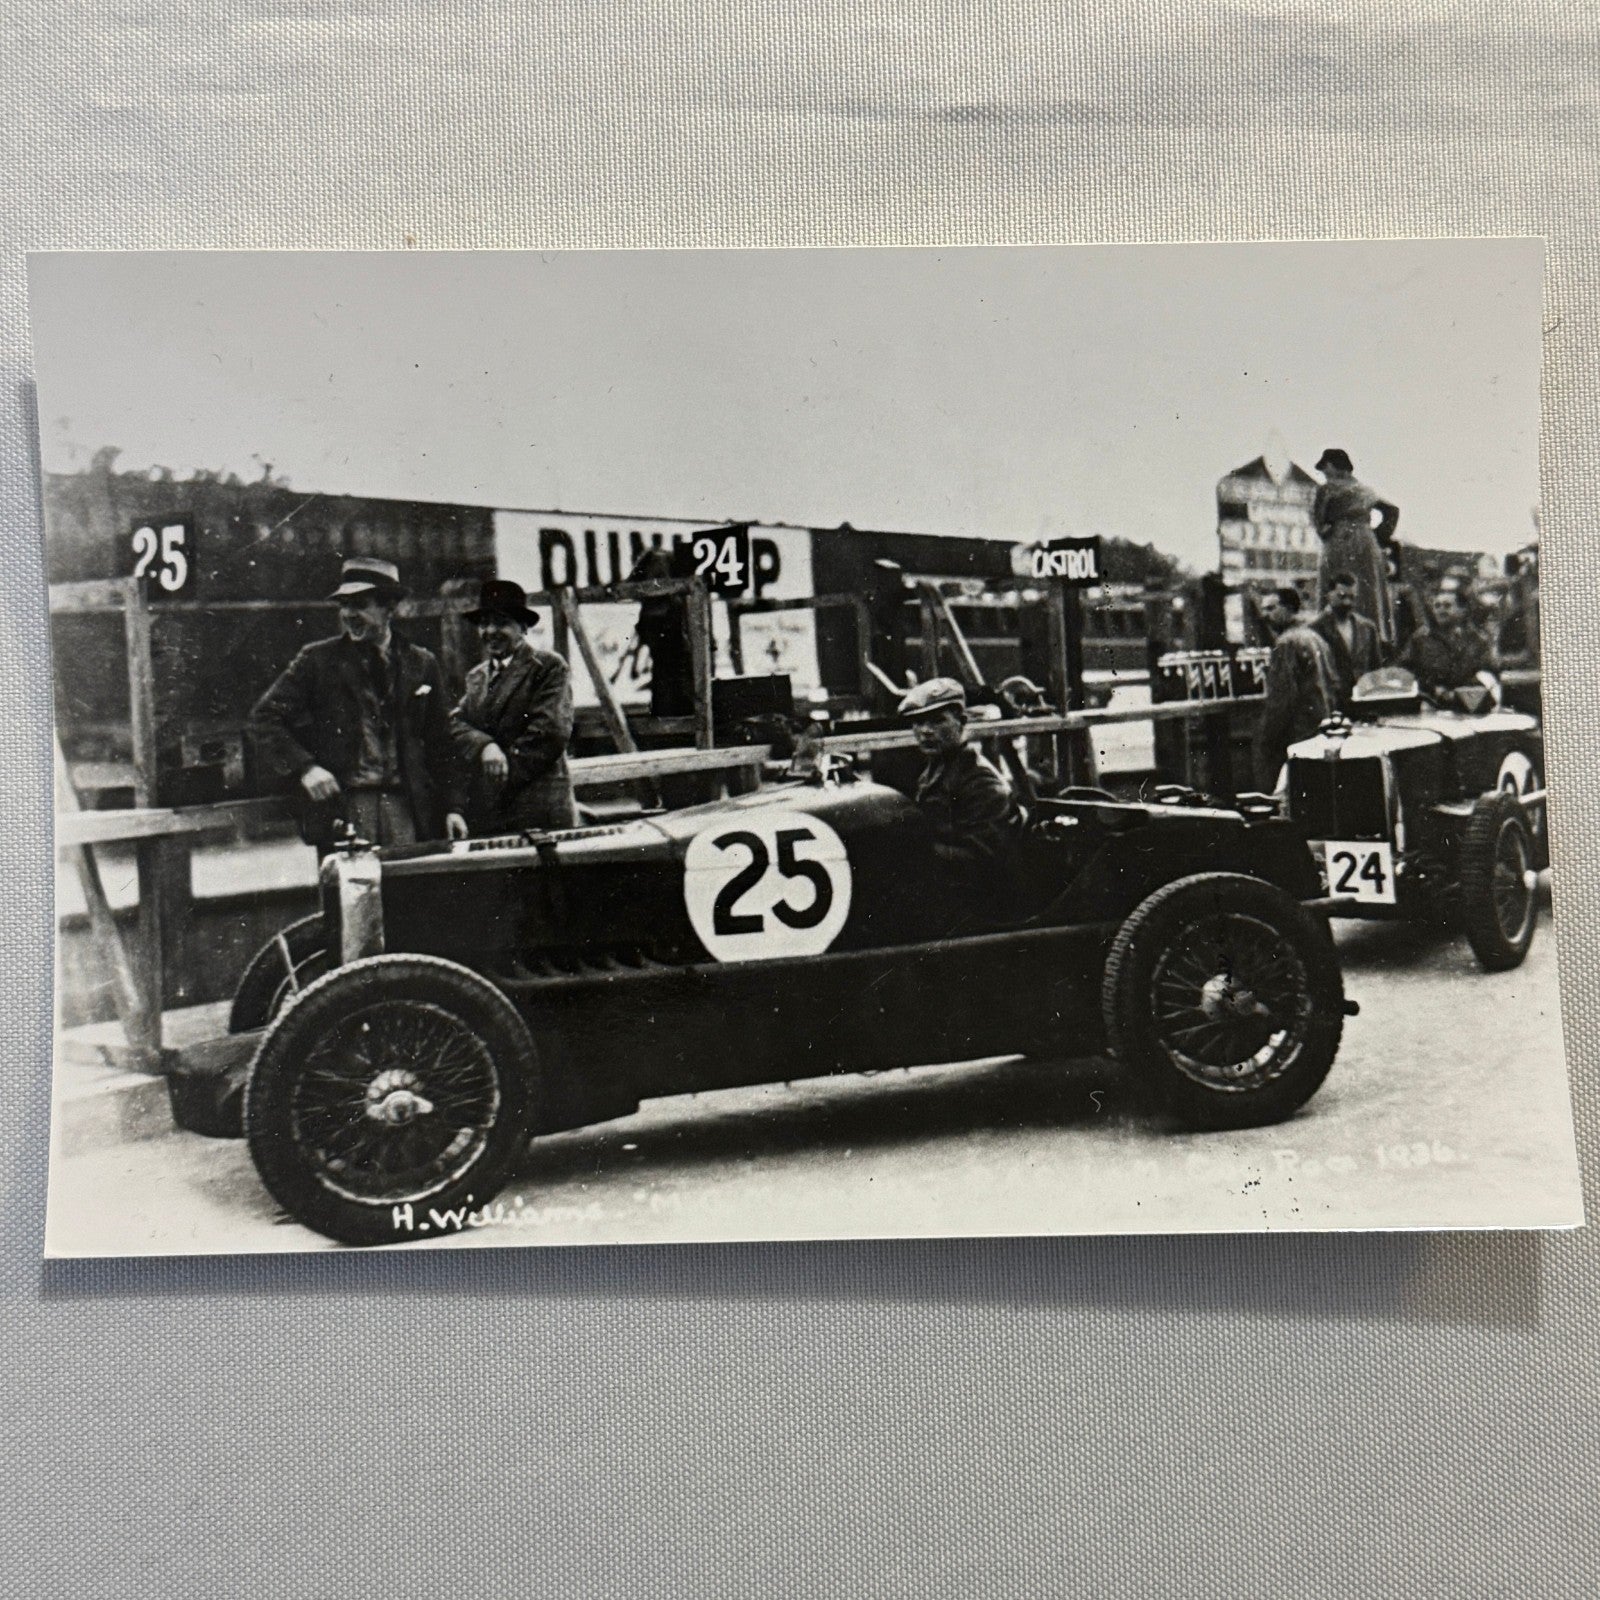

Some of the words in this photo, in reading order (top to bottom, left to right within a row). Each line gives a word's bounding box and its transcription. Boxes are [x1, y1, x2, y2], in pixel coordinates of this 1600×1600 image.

[132, 524, 188, 592] 25
[692, 536, 745, 587] 24
[1031, 547, 1098, 579] CASTROL
[711, 827, 833, 936] 25
[1332, 850, 1387, 895] 24
